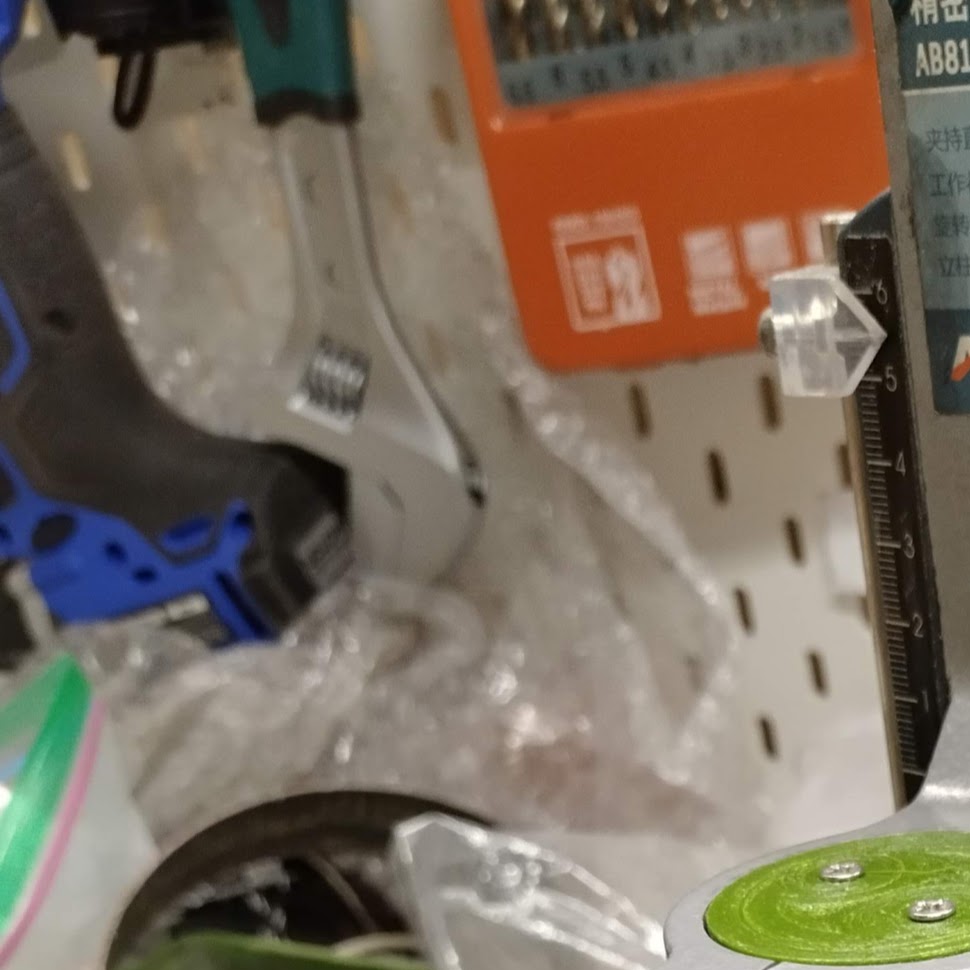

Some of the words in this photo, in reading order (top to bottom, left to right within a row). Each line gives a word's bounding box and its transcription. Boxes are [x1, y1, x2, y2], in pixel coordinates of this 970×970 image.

[875, 278, 888, 305] 6
[885, 365, 897, 392] 5
[895, 451, 906, 477] 4
[904, 533, 916, 559] 3
[912, 612, 924, 638] 2
[921, 689, 929, 713] 1
